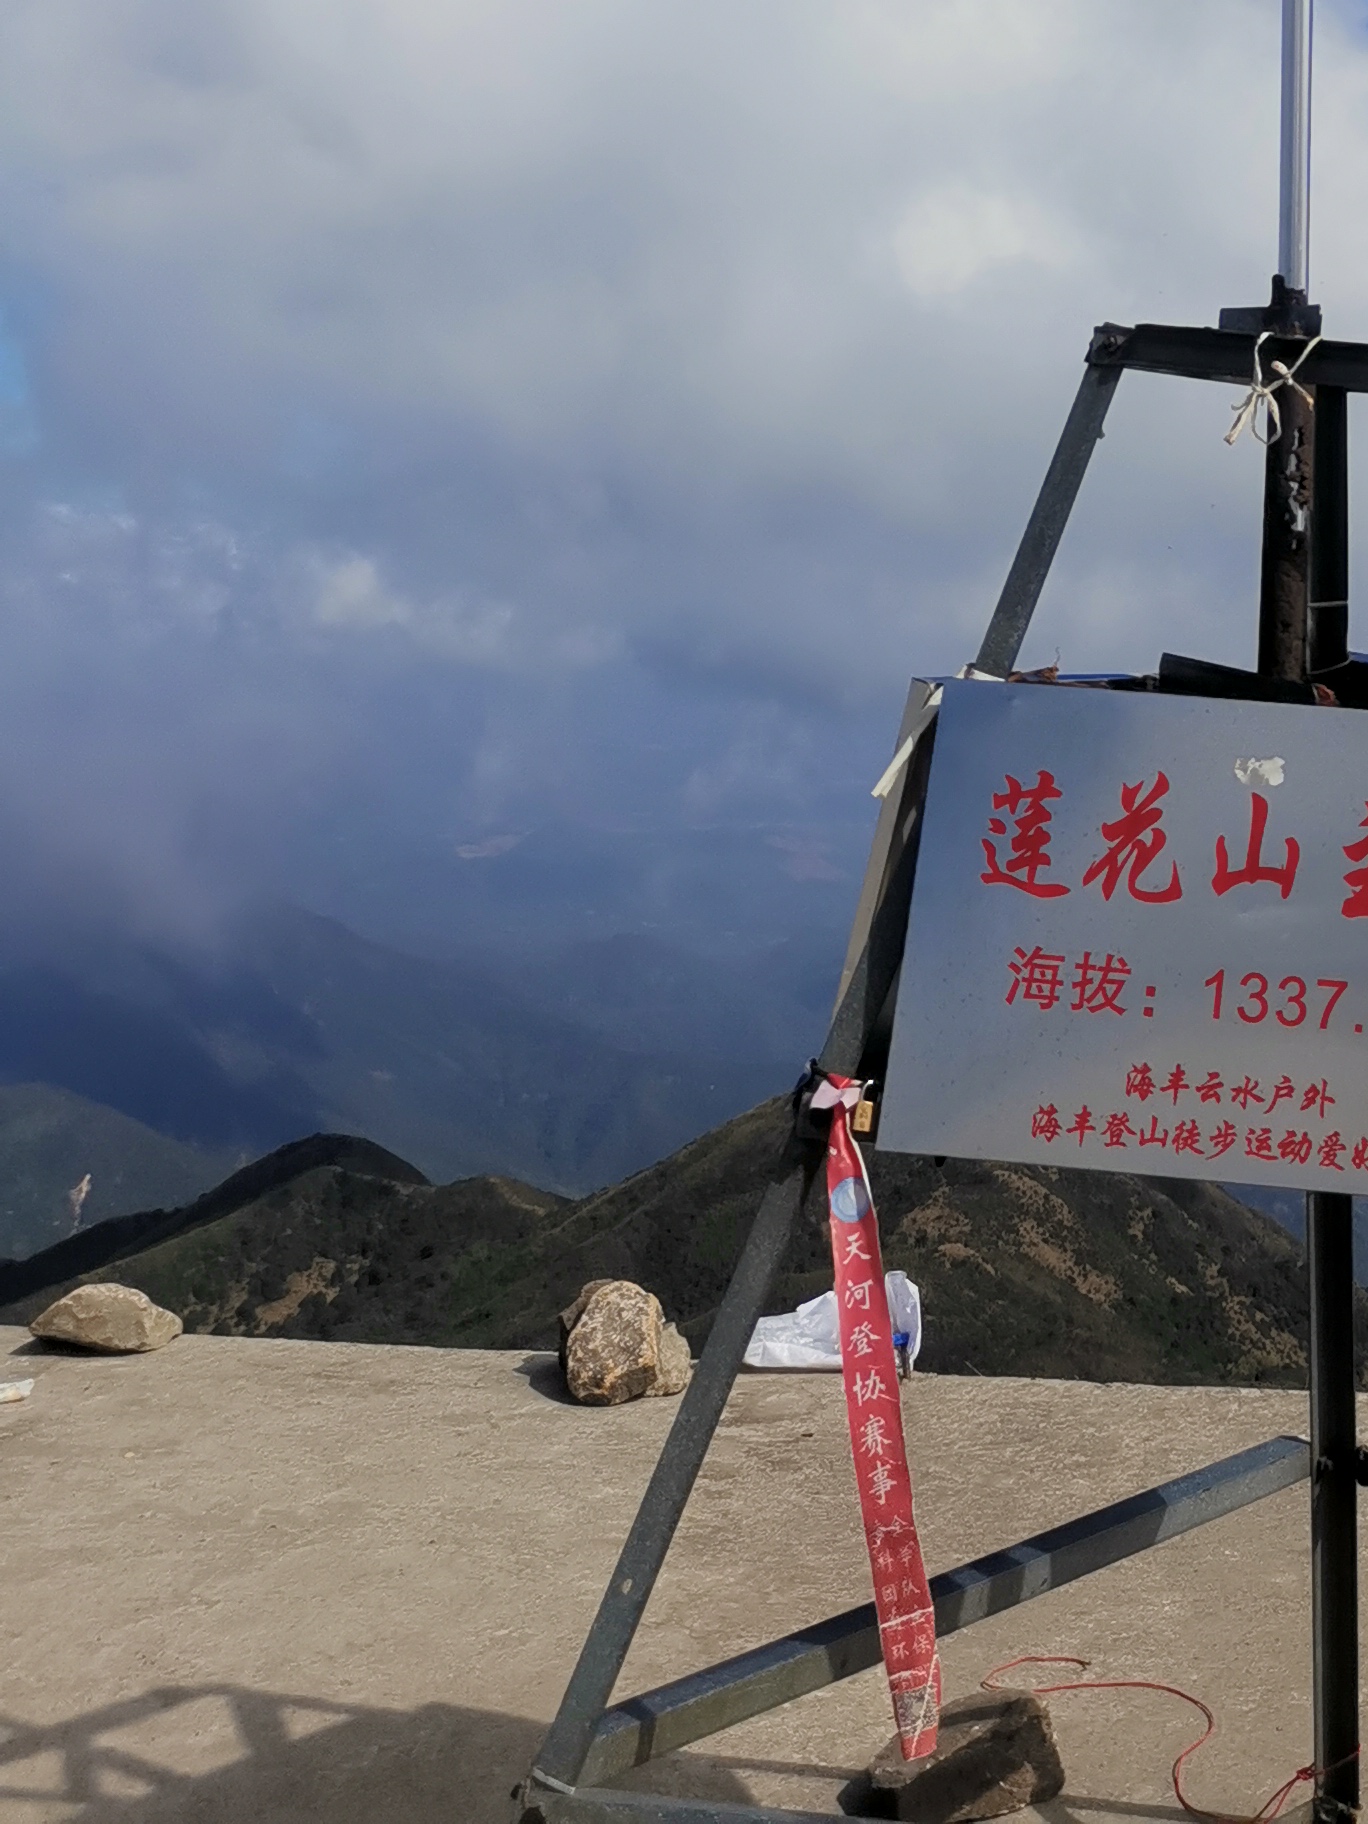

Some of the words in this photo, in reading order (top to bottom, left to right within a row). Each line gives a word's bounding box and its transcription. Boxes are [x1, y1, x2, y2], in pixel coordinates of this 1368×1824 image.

[1125, 1062, 1336, 1119] 海丰云水户外
[842, 1231, 899, 1506] 天河登协赛事
